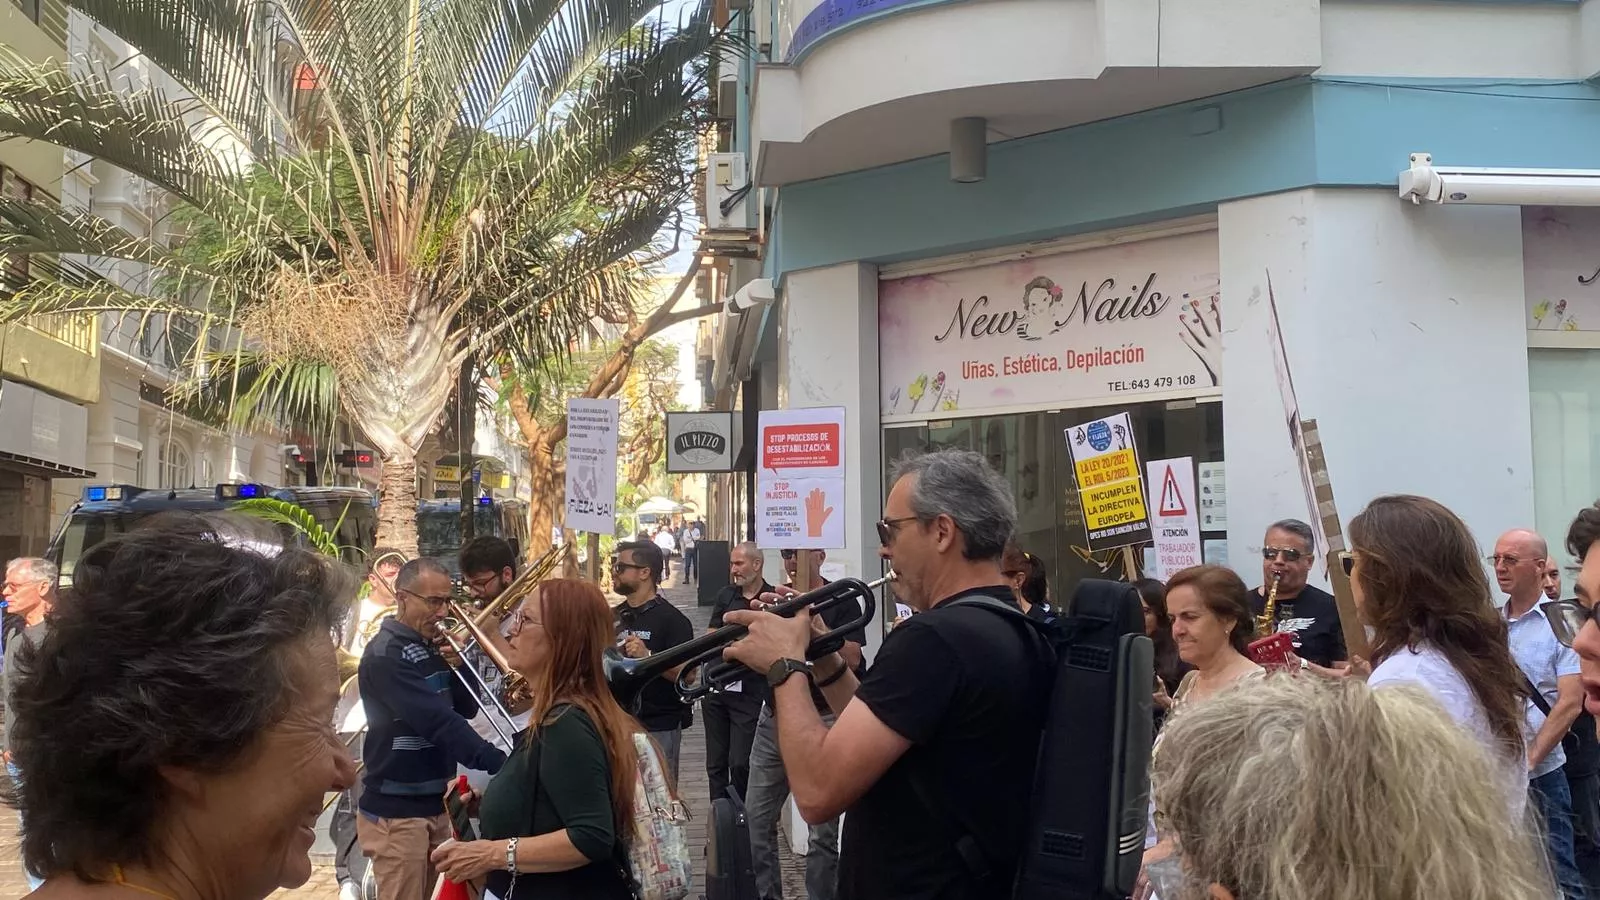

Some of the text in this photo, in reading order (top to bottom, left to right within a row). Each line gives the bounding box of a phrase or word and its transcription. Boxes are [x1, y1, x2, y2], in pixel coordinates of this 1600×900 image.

[934, 272, 1172, 342] New Nails
[1067, 343, 1144, 372] Depilación
[1108, 375, 1196, 392] TEL:643 479 108
[680, 433, 719, 449] IL PIZZO
[770, 432, 829, 443] STOP PROCESOS DE
[1080, 453, 1129, 473] LA LEY 20/2021
[1085, 476, 1093, 486] EL
[1106, 466, 1130, 481] 5/2023
[774, 482, 789, 491] STOP
[1090, 484, 1137, 502] INCUMPLEN
[766, 491, 798, 499] INJUSTICIA
[1087, 506, 1098, 516] LA
[1099, 497, 1140, 513] DIRECTIVA
[1097, 510, 1136, 526] EUROPEA
[1158, 543, 1196, 553] TRABAJADOR
[1186, 555, 1195, 565] EN
